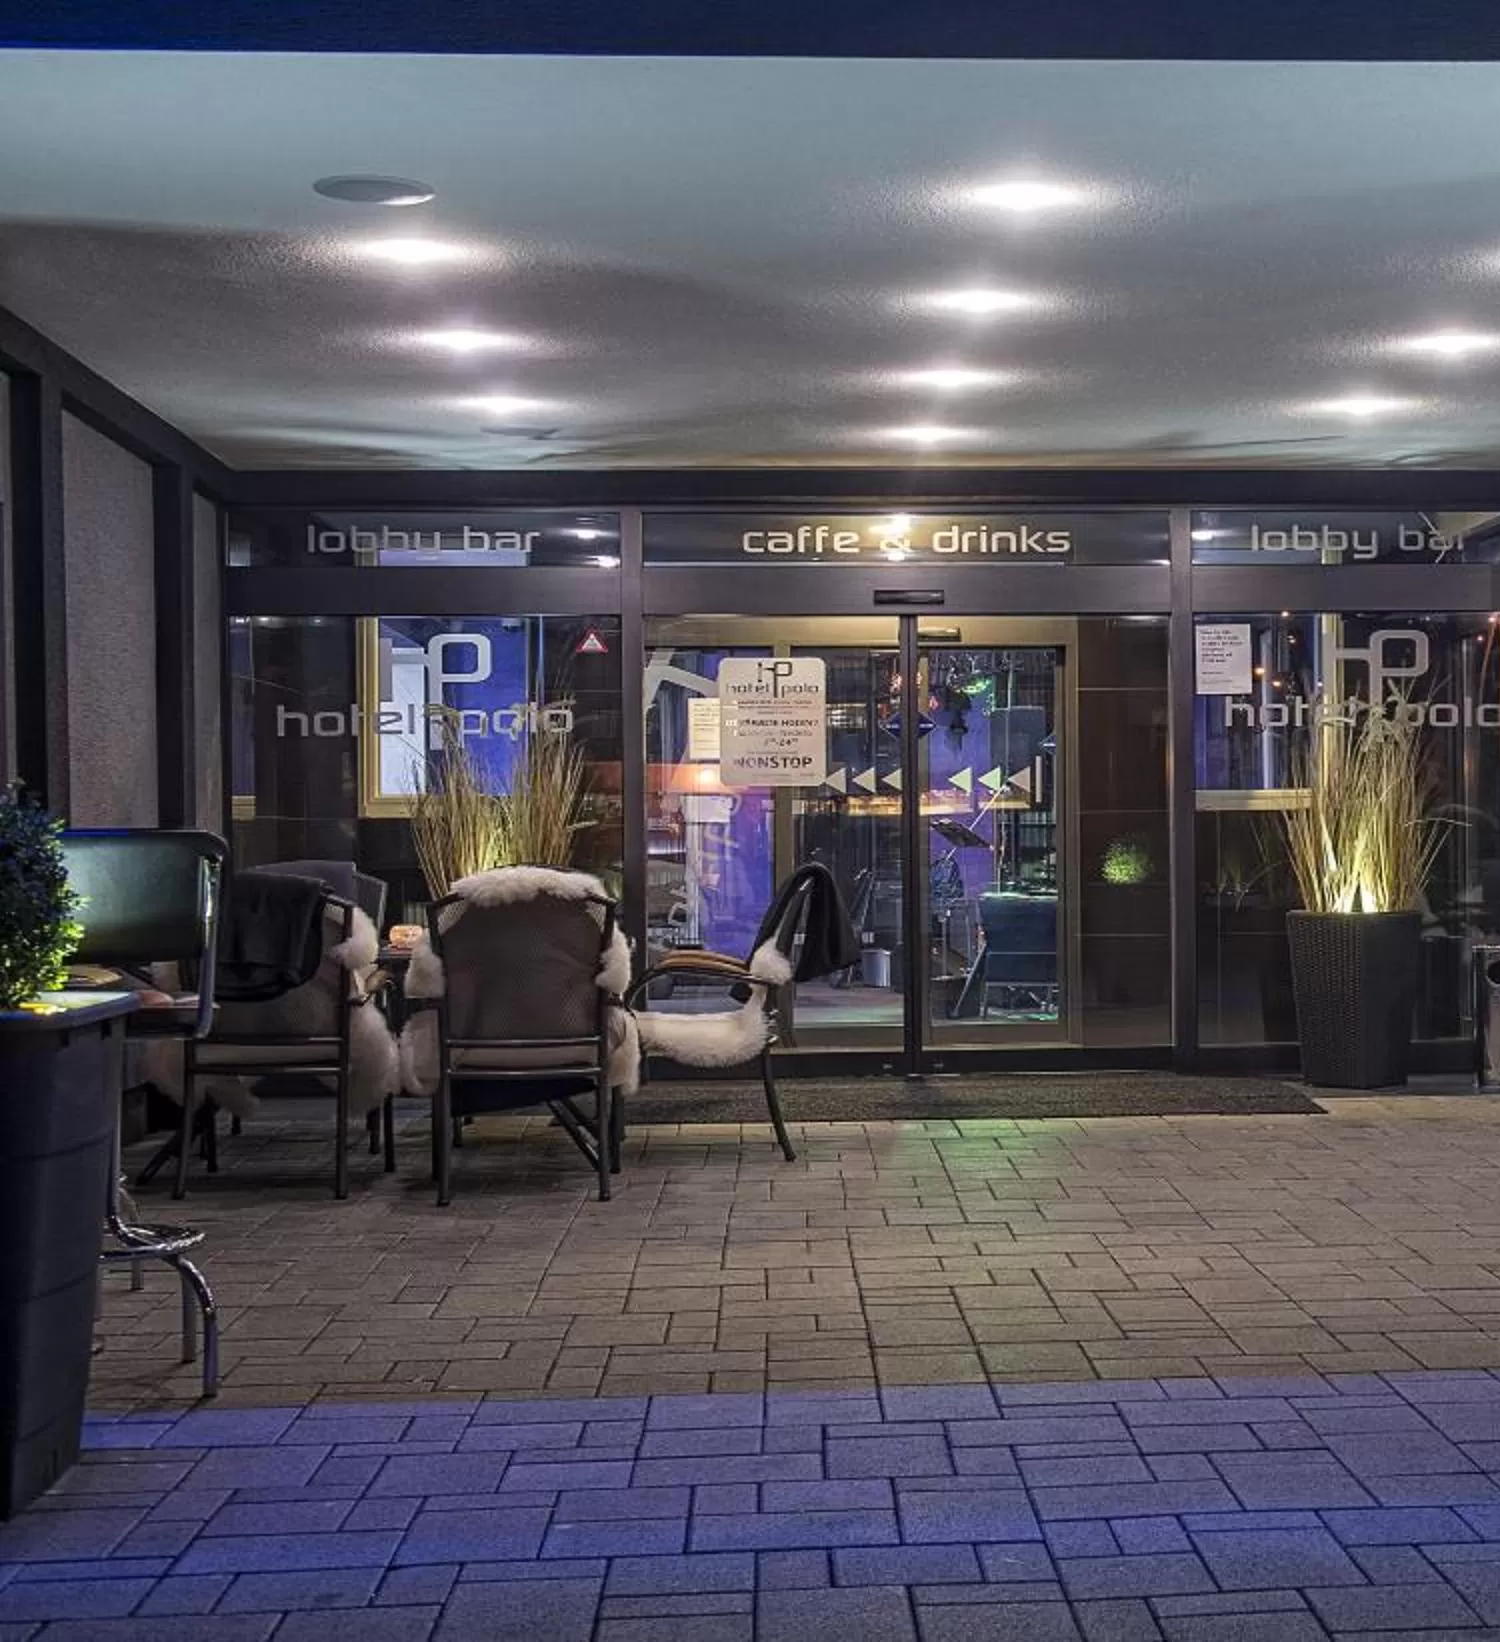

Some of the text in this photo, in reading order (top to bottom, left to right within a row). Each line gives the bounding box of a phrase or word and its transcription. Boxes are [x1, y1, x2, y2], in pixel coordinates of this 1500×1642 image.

[306, 525, 540, 560] lobby bar
[743, 525, 1072, 553] caffe & drinks
[1251, 524, 1378, 559] lobby
[277, 701, 573, 749] hotel polo
[734, 756, 813, 769] NONSTOP
